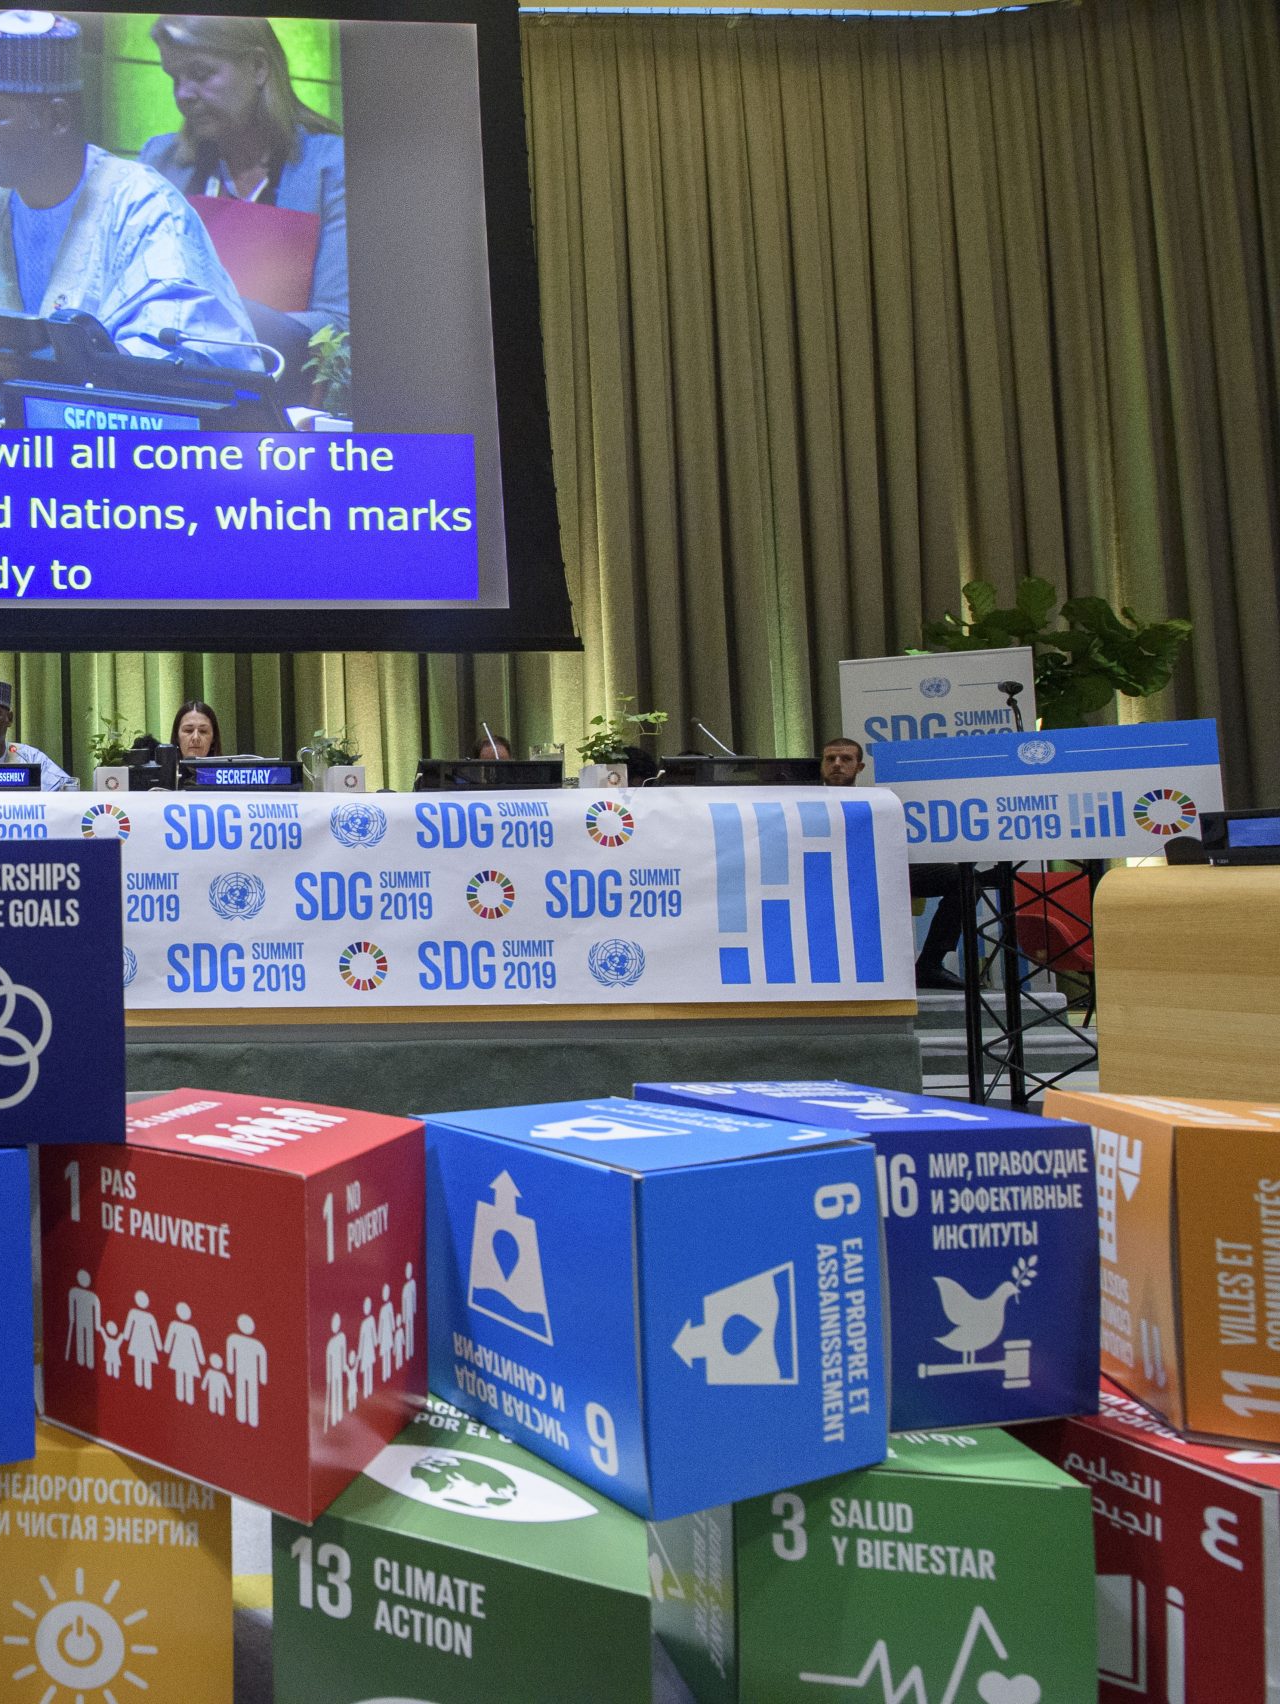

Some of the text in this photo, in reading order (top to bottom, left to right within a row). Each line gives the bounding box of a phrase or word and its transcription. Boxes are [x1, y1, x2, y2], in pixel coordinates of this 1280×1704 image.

[72, 437, 115, 470] all
[133, 447, 242, 471] come
[259, 438, 315, 471] for
[329, 439, 394, 472] the
[30, 497, 198, 535] Nations,
[217, 499, 331, 531] which
[349, 499, 472, 532] marks
[51, 561, 91, 590] to
[864, 713, 947, 753] SDG
[954, 709, 1011, 726] SUMMIT
[216, 769, 270, 784] SECRETARY
[248, 803, 299, 819] SUMMIT
[500, 802, 549, 817] SUMMIT
[903, 798, 990, 843] SDG
[996, 795, 1058, 812] SUMMIT
[164, 804, 242, 850] SDG
[250, 823, 302, 850] 2019
[416, 802, 493, 849] SDG
[502, 820, 553, 848] 2019
[998, 814, 1061, 840] 2019
[127, 873, 179, 890] SUMMIT
[380, 871, 431, 889] SUMMIT
[545, 869, 622, 918] SDG
[629, 868, 681, 886] SUMMIT
[8, 898, 80, 927] GOALS
[127, 894, 179, 922] 2019
[295, 871, 373, 921] SDG
[380, 893, 432, 920] 2019
[630, 890, 682, 918] 2019
[252, 942, 304, 960] SUMMIT
[419, 940, 496, 990] SDG
[503, 940, 554, 957] SUMMIT
[167, 943, 245, 992] SDG
[253, 964, 306, 992] 2019
[504, 962, 556, 989] 2019
[929, 1149, 1088, 1181] МИР, ПРАВОСУДИЕ
[65, 1160, 80, 1222] 1
[100, 1166, 137, 1200] PAS
[346, 1180, 362, 1214] NO
[876, 1154, 919, 1218] 16
[931, 1184, 1083, 1214] И ЭФФЕКТИВНЫЕ
[814, 1182, 861, 1220] 6
[101, 1201, 230, 1259] DE PAUVRETÉ
[323, 1192, 335, 1264] 1
[347, 1203, 389, 1252] POVERTY
[933, 1221, 1039, 1250] ИНСТИТУТЫ
[1216, 1238, 1257, 1344] VILLES ET
[816, 1243, 844, 1443] ASSAINISSEMENT
[841, 1238, 869, 1415] EAU PROPRE ET
[453, 1332, 546, 1401] САНИТАРИЯ
[454, 1364, 570, 1450] ЧИСТАЯ ВОДА
[1221, 1370, 1280, 1418] 11
[414, 1412, 460, 1432] POR
[465, 1422, 491, 1439] EL
[1064, 1452, 1161, 1505] التعليم
[15, 1512, 98, 1542] ЧИСТАЯ
[103, 1517, 199, 1547] ЭНЕРГИЯ
[771, 1492, 808, 1561] 3
[830, 1498, 913, 1534] SALUD
[832, 1536, 996, 1581] Y BIENESTAR
[290, 1536, 352, 1619] 13
[374, 1557, 486, 1619] CLIMATE
[374, 1599, 473, 1659] ACTION
